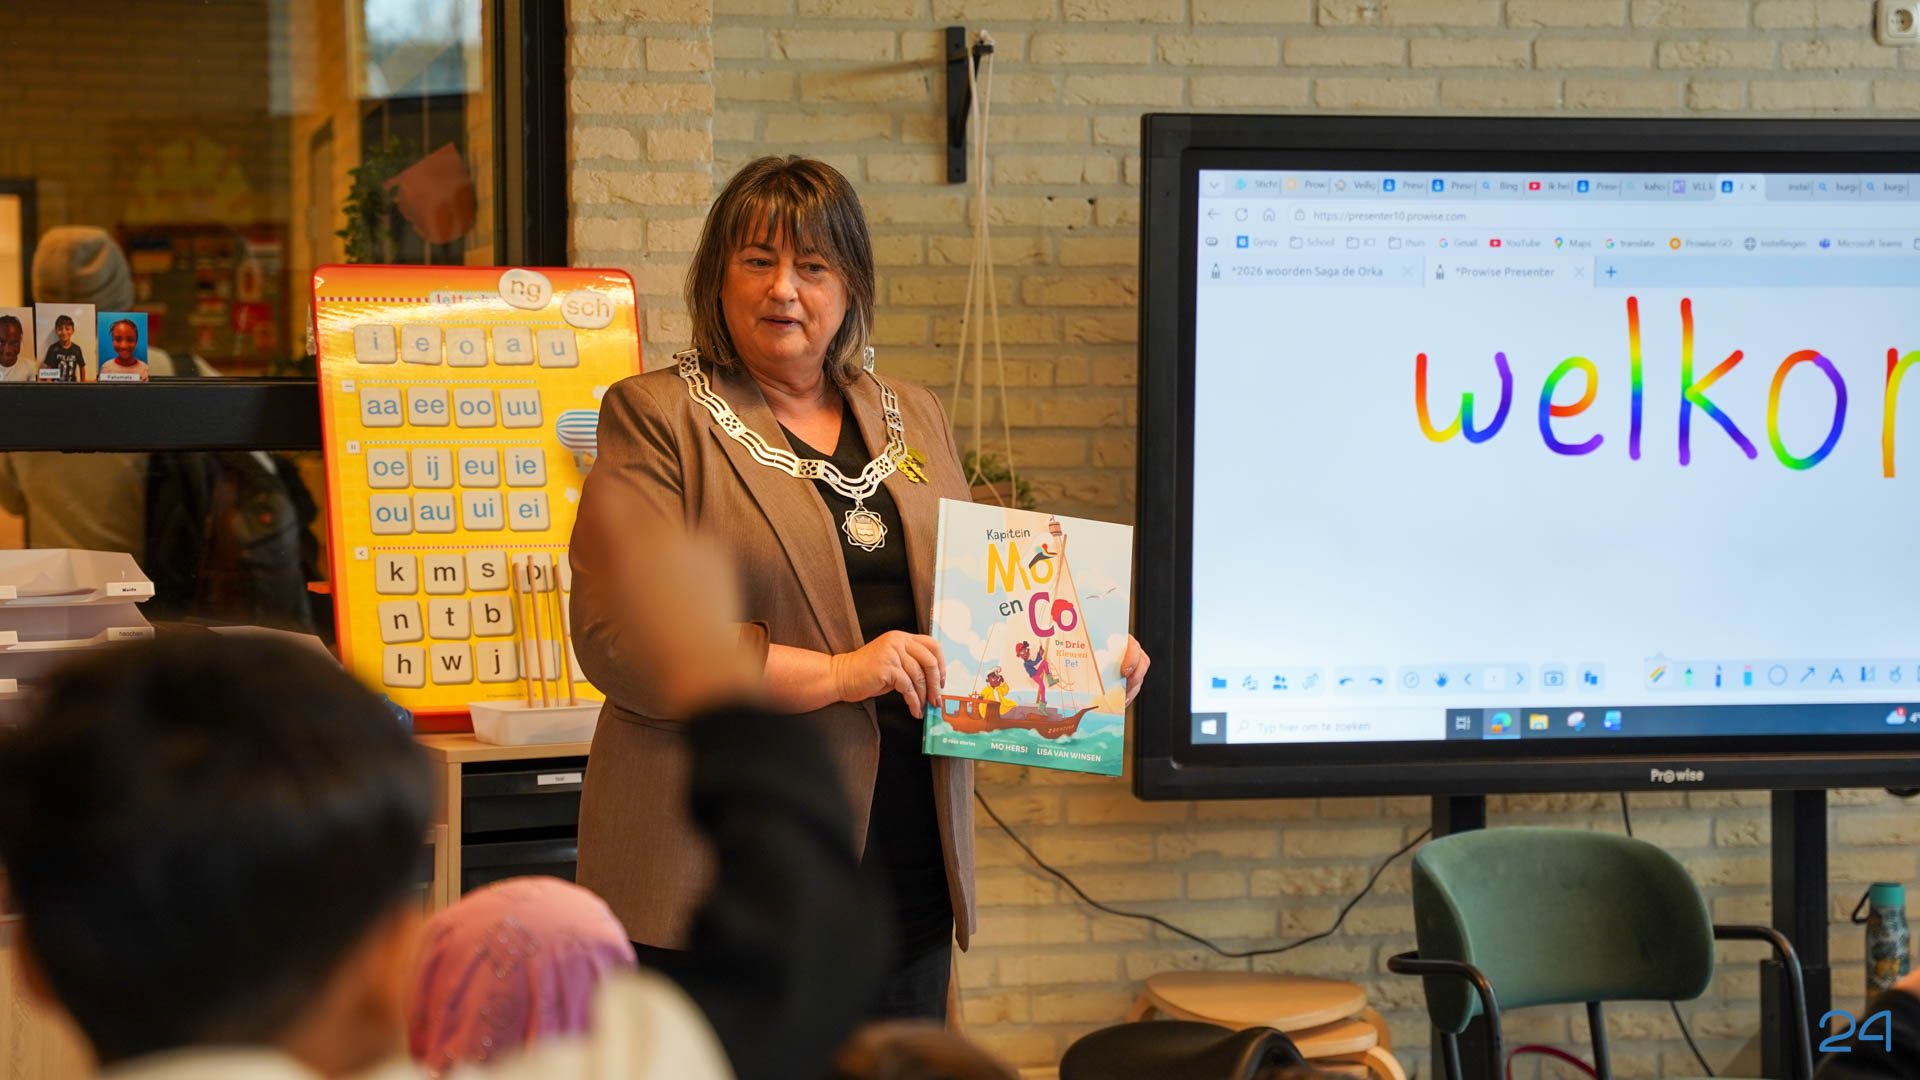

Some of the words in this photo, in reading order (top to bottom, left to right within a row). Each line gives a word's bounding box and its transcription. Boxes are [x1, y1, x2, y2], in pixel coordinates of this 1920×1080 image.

[1306, 236, 1336, 248] School
[1454, 238, 1478, 249] Gmail
[1506, 238, 1541, 249] YouTube
[1569, 238, 1592, 251] Maps
[1265, 266, 1312, 278] woorden
[1315, 266, 1340, 281] Saga
[1342, 266, 1355, 278] de
[1358, 266, 1384, 278] Orka
[1504, 266, 1556, 278] Presenter
[510, 278, 542, 304] ng
[566, 298, 610, 318] sch
[415, 336, 431, 353] e
[459, 339, 474, 356] o
[506, 336, 521, 353] a
[551, 339, 566, 357] u
[367, 398, 399, 416] aa
[414, 397, 445, 415] ee
[459, 399, 492, 417] oo
[506, 399, 538, 417] uu
[372, 459, 406, 477] oe
[427, 455, 440, 481] ij
[464, 459, 496, 477] eu
[514, 454, 537, 475] ie
[375, 505, 408, 523] ou
[420, 503, 451, 521] au
[472, 497, 495, 518] ui
[518, 497, 540, 519] ei
[986, 528, 1031, 543] Kapitein
[390, 560, 405, 582] k
[433, 564, 457, 583] m
[481, 561, 496, 578] s
[986, 541, 1055, 594] Mo
[394, 612, 409, 631] n
[445, 606, 455, 627] t
[484, 602, 501, 624] b
[998, 598, 1025, 617] en
[1028, 591, 1078, 638] Co
[1065, 640, 1086, 650] Drie
[397, 653, 412, 675] h
[441, 653, 463, 671] w
[493, 648, 501, 675] j
[1064, 659, 1079, 668] Pet
[991, 742, 1004, 751] MO
[1005, 744, 1028, 753] HERSI
[1036, 747, 1053, 756] LISA
[1053, 749, 1070, 758] VAN
[1070, 751, 1102, 762] WINSEN
